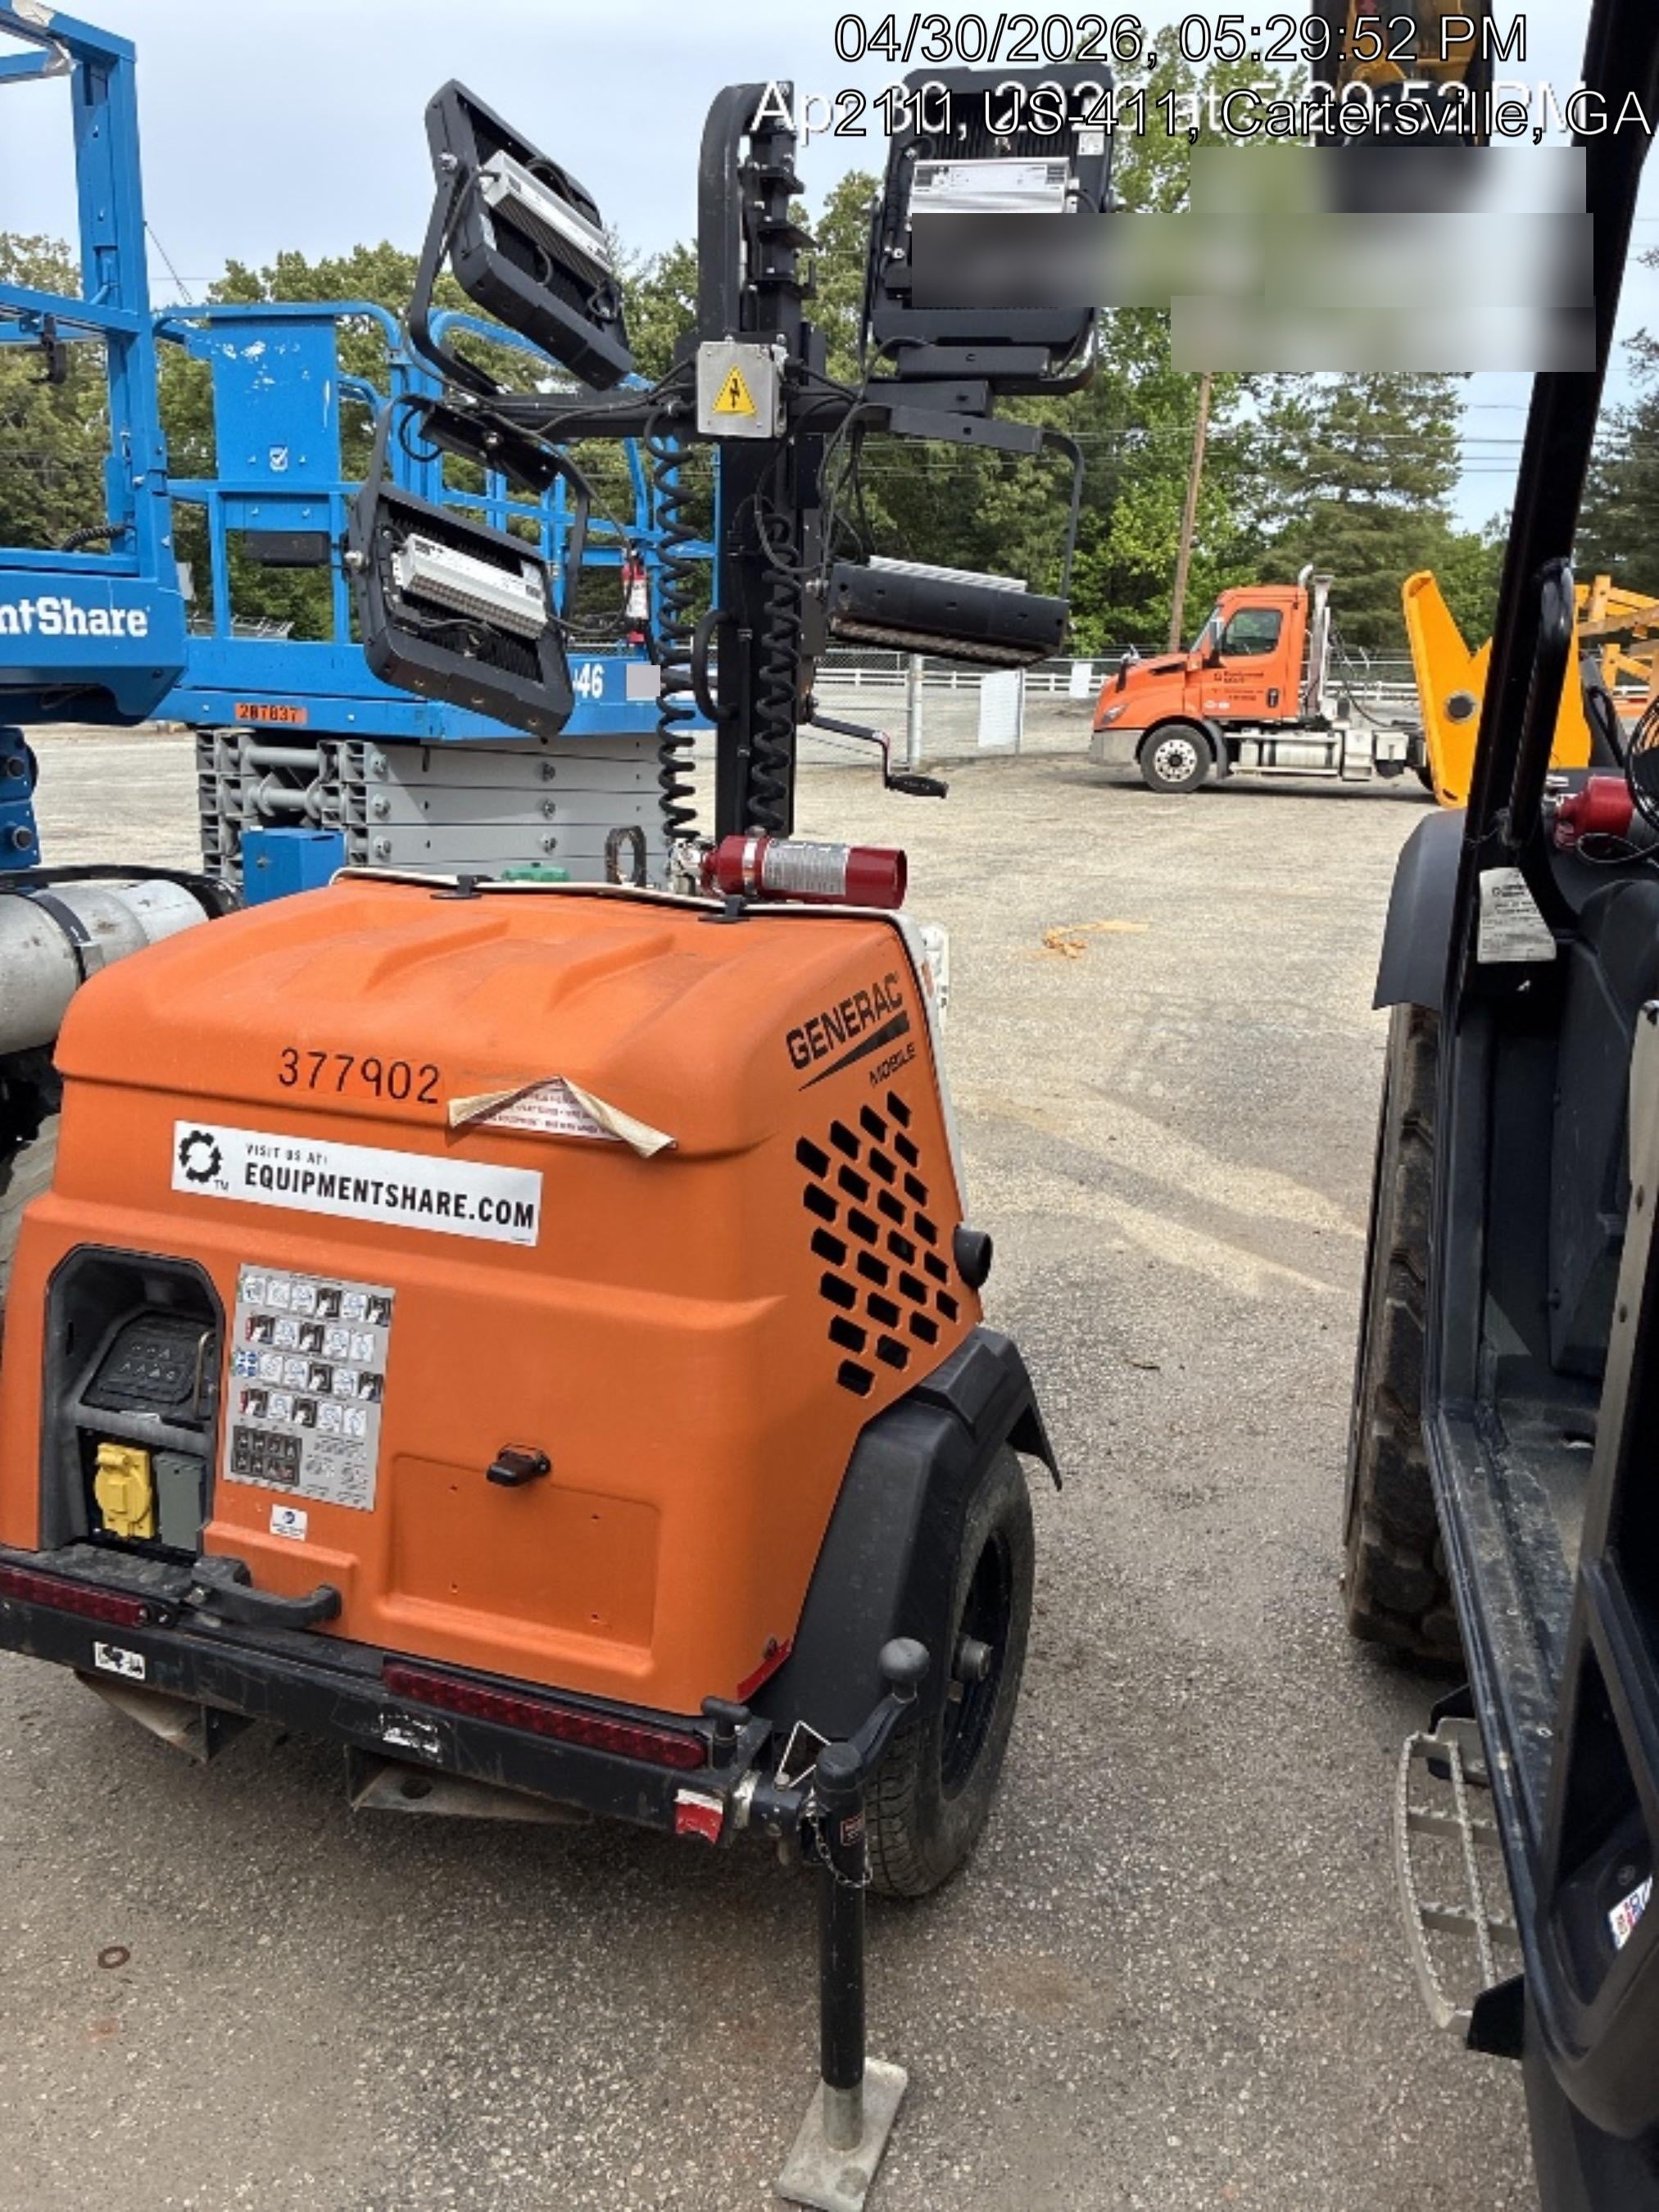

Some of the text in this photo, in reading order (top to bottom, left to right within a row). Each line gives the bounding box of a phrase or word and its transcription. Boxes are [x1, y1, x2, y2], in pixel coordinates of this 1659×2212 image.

[786, 972, 903, 1070] GENERAC
[278, 1046, 440, 1104] 377902
[869, 1042, 916, 1088] MOBILE
[246, 1143, 280, 1158] VISIT
[214, 1178, 229, 1191] TM
[245, 1162, 535, 1229] EQUIPMENTSHARE.COM
